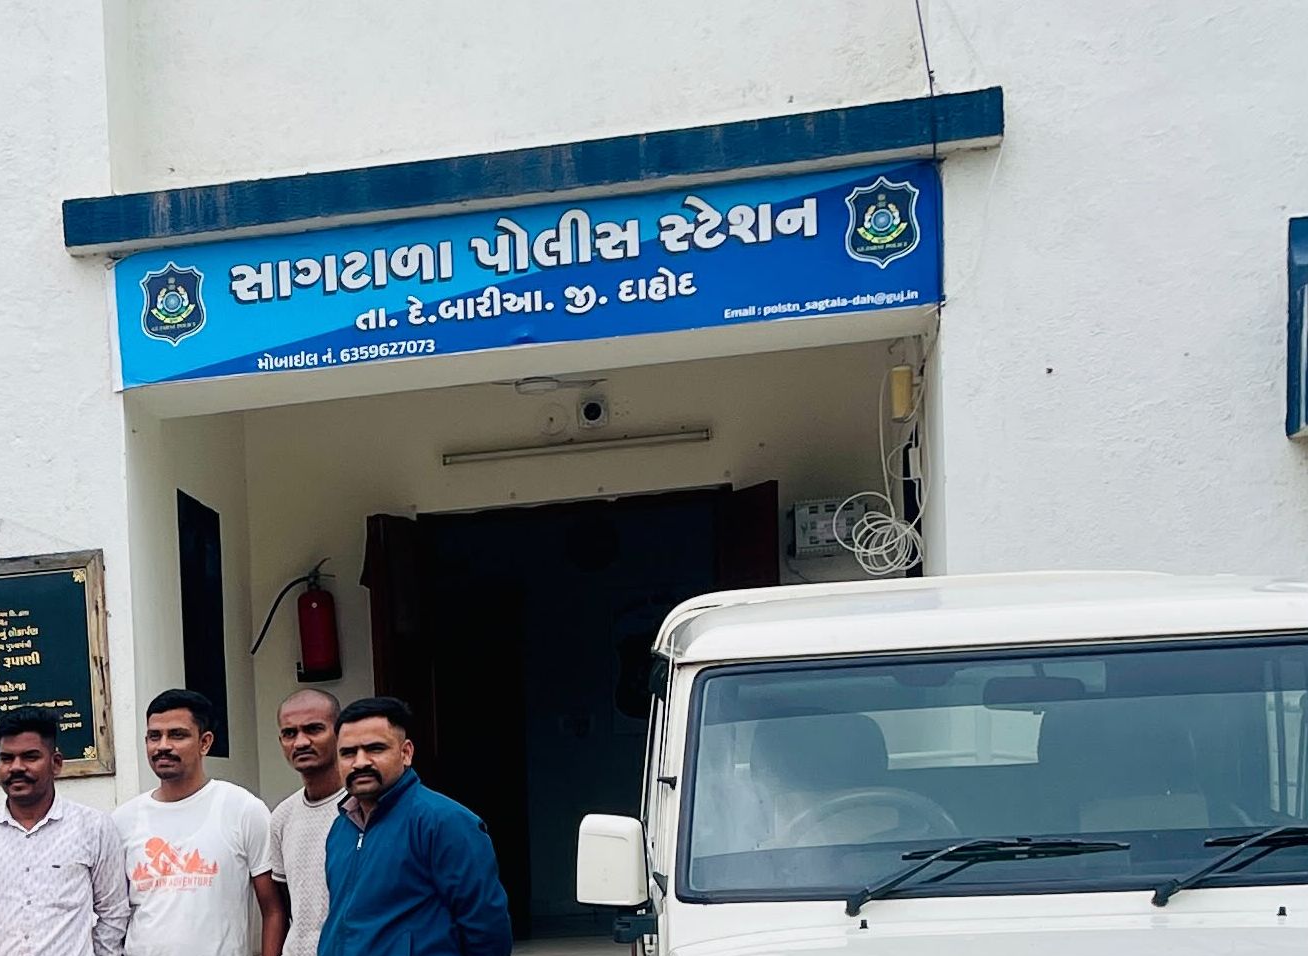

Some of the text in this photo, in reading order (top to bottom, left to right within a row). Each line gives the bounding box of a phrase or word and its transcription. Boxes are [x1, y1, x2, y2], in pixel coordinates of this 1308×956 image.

[231, 195, 818, 302] સાગટાળા પોલીસ સ્ટેશન
[355, 308, 398, 331] તા.
[564, 284, 608, 314] જી.
[618, 267, 698, 303] દાહોદ
[723, 306, 756, 319] Email
[340, 338, 435, 364] 6359627073
